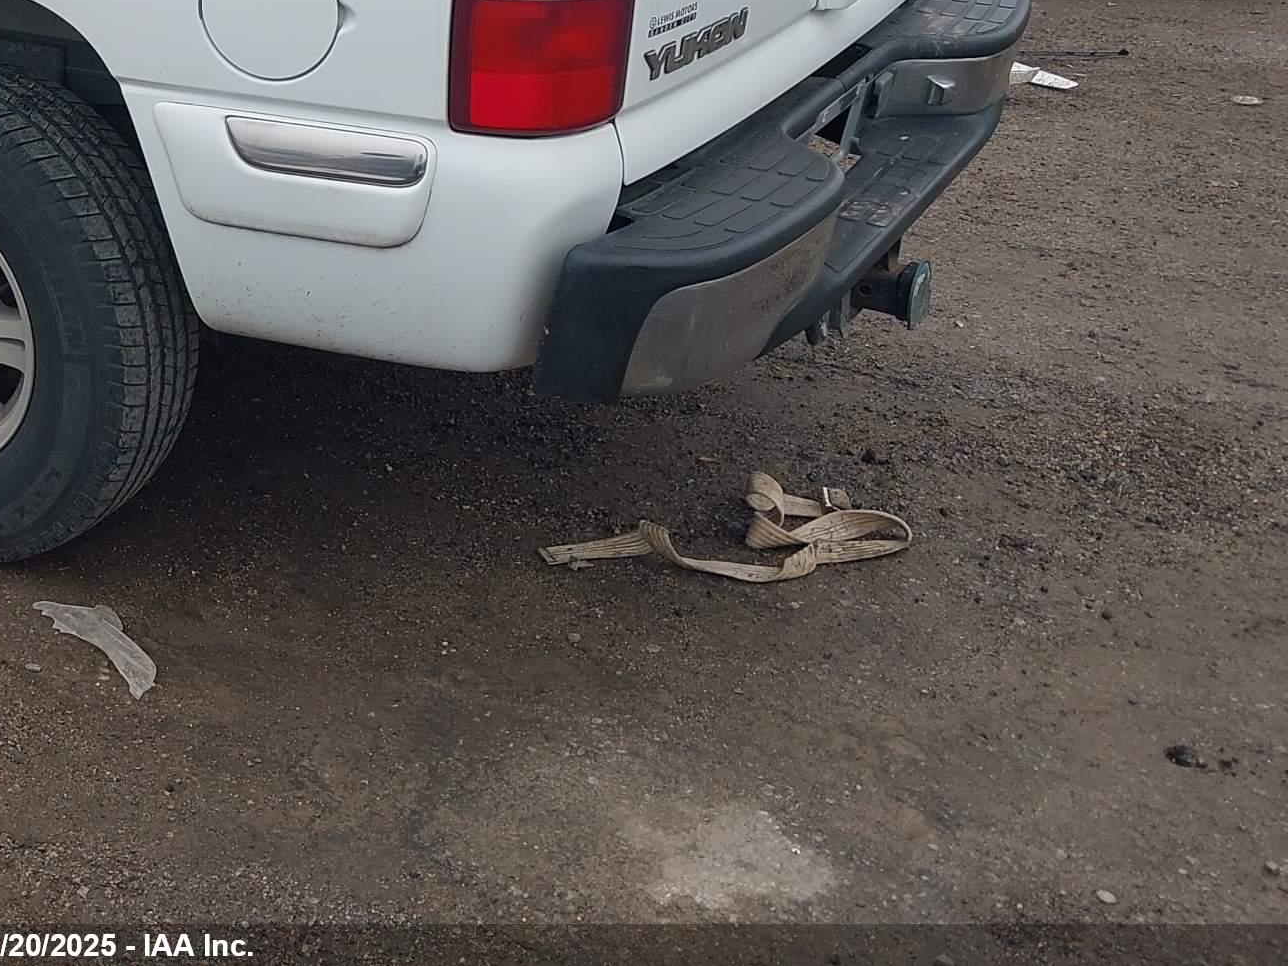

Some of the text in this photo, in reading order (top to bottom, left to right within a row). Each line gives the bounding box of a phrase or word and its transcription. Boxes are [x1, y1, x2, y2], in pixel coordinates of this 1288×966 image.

[657, 1, 698, 26] LEWIS MOTORS
[644, 7, 749, 81] YUKON
